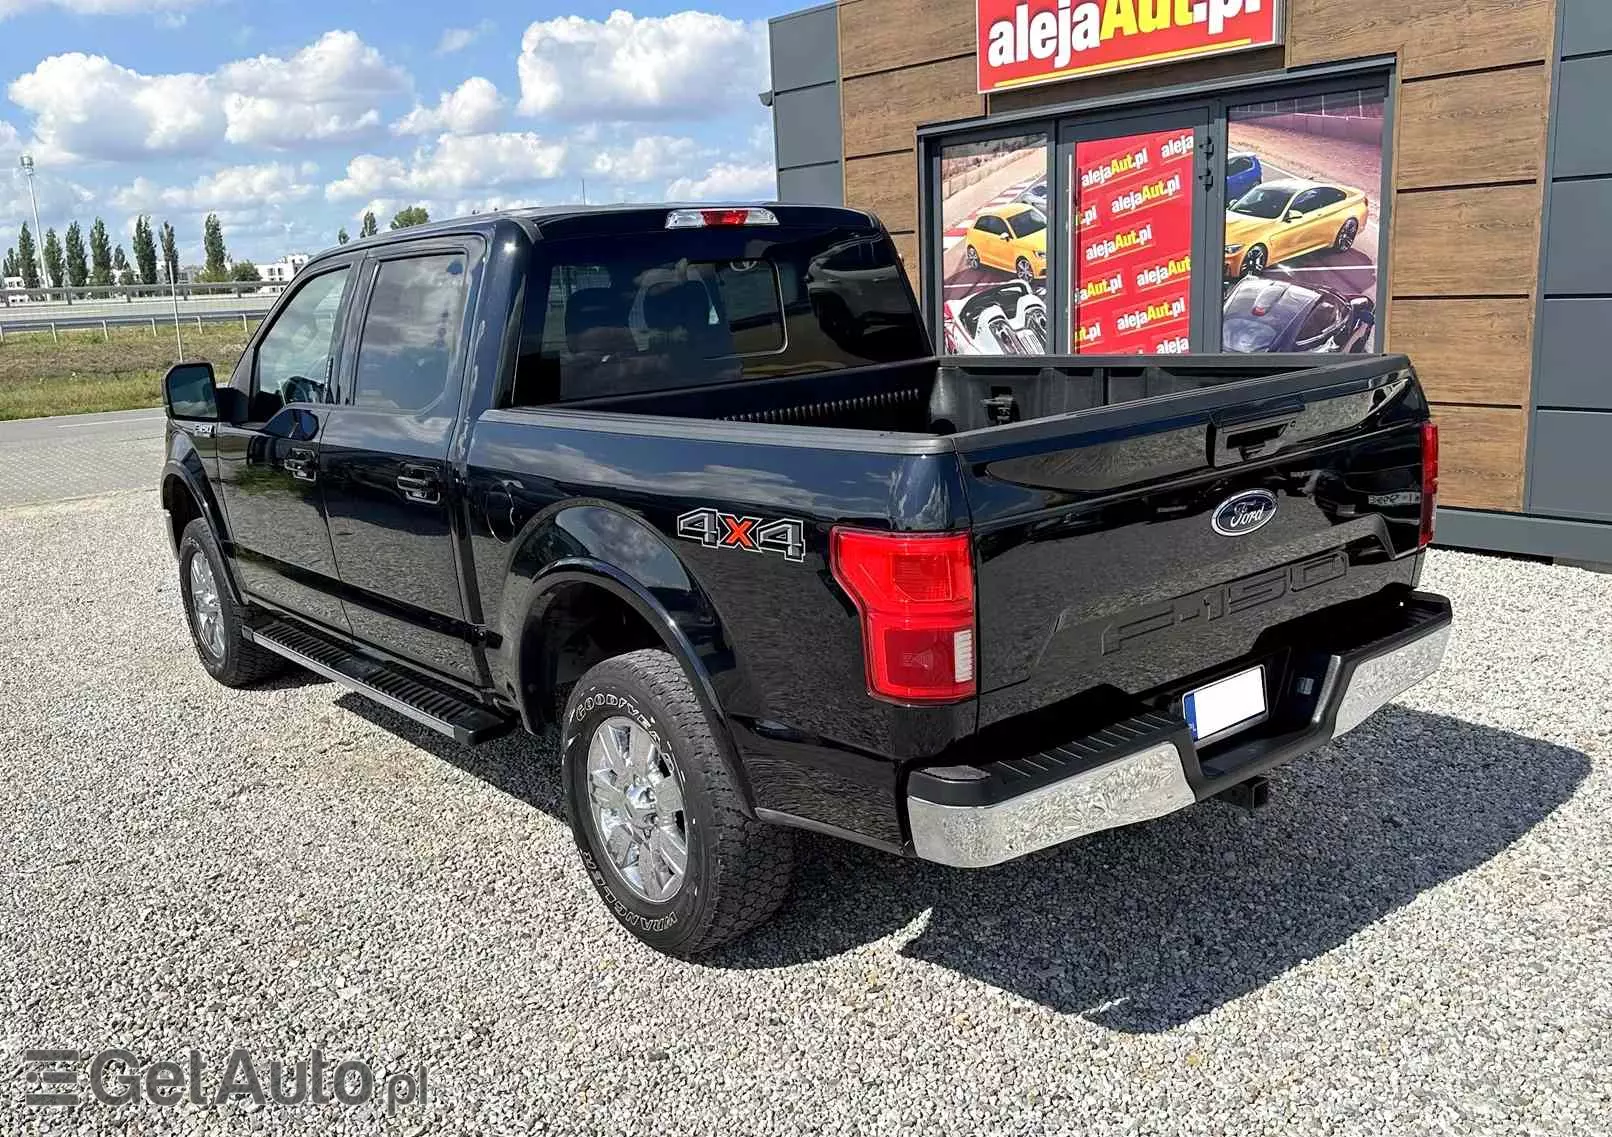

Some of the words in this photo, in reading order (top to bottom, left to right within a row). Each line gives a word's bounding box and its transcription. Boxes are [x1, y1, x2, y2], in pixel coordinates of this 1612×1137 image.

[1081, 147, 1149, 188] alejaAut.pl
[1111, 174, 1181, 213] alejaAut.pl
[1085, 223, 1152, 261] alejaAut.pl
[1116, 297, 1185, 331] alejaAut.pl
[1229, 500, 1266, 528] Ford
[1101, 551, 1350, 657] F-150
